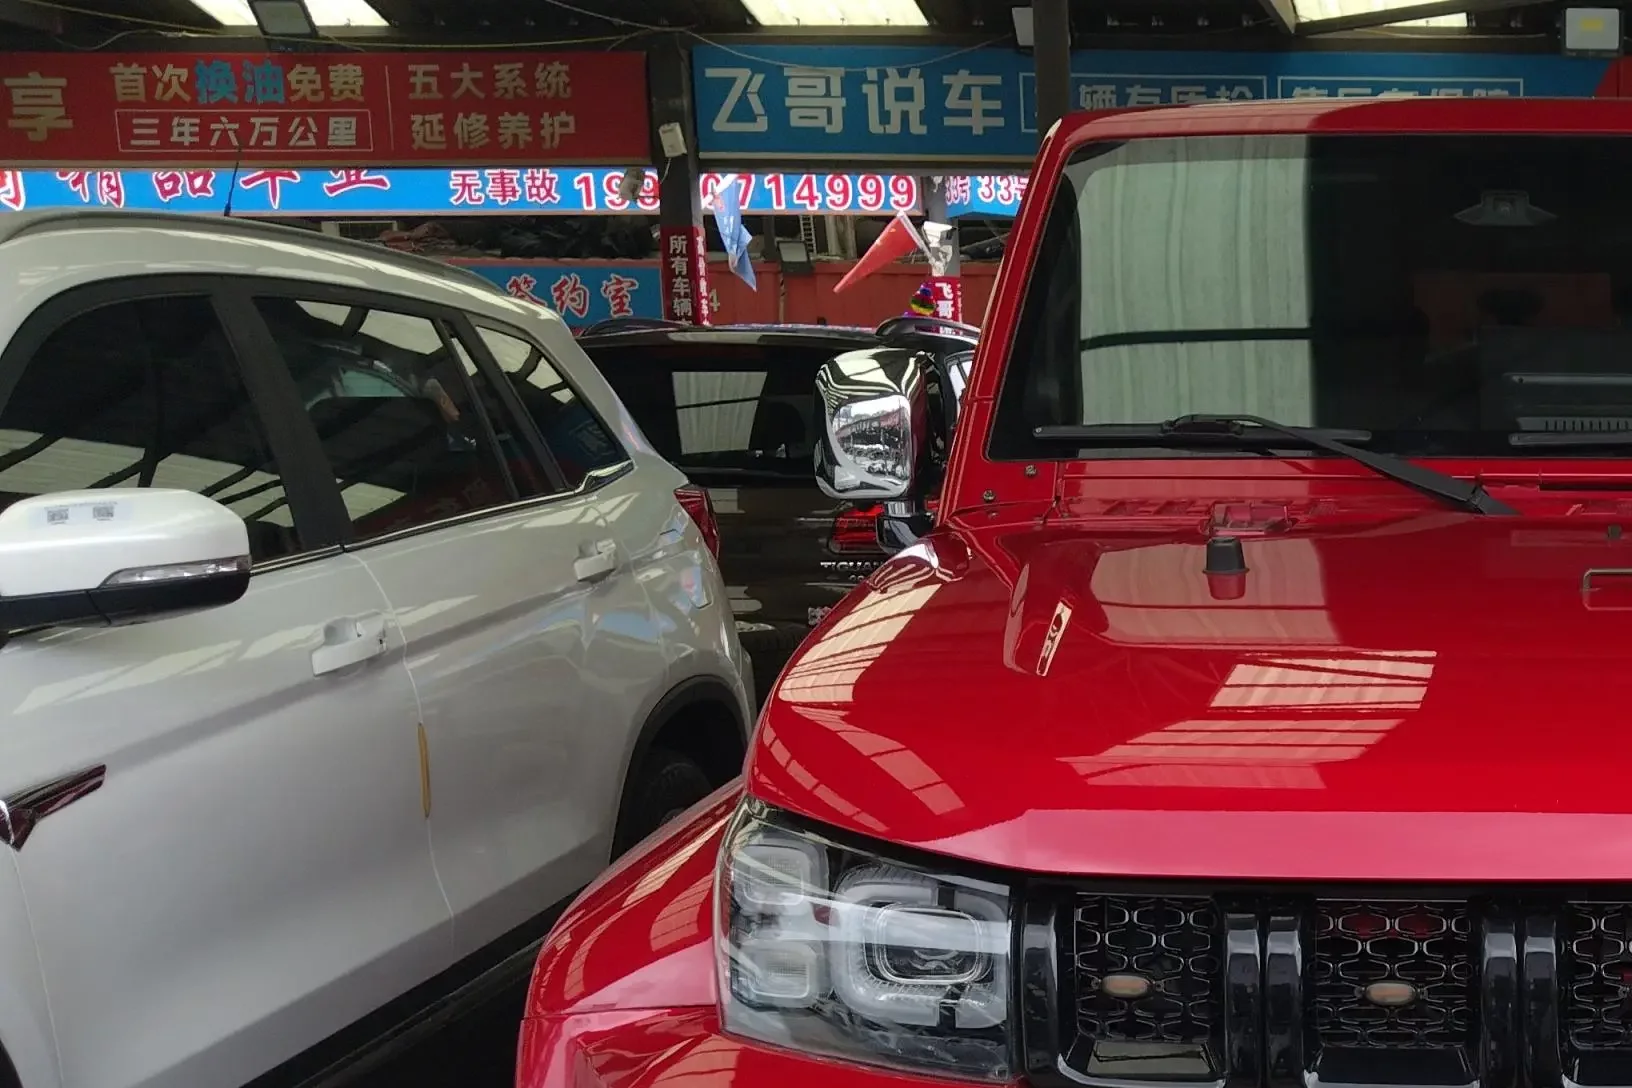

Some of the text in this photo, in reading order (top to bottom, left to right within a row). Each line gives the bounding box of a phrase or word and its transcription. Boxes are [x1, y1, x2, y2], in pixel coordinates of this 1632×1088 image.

[109, 60, 366, 105] 首次换油免费
[408, 62, 573, 100] 五大系统
[704, 66, 1006, 136] 飞哥说车
[3, 73, 74, 142] 享
[130, 118, 358, 147] 三年六万公里
[410, 112, 576, 150] 延修养护
[450, 168, 560, 206] 无事故
[669, 234, 693, 325] 所有车辆
